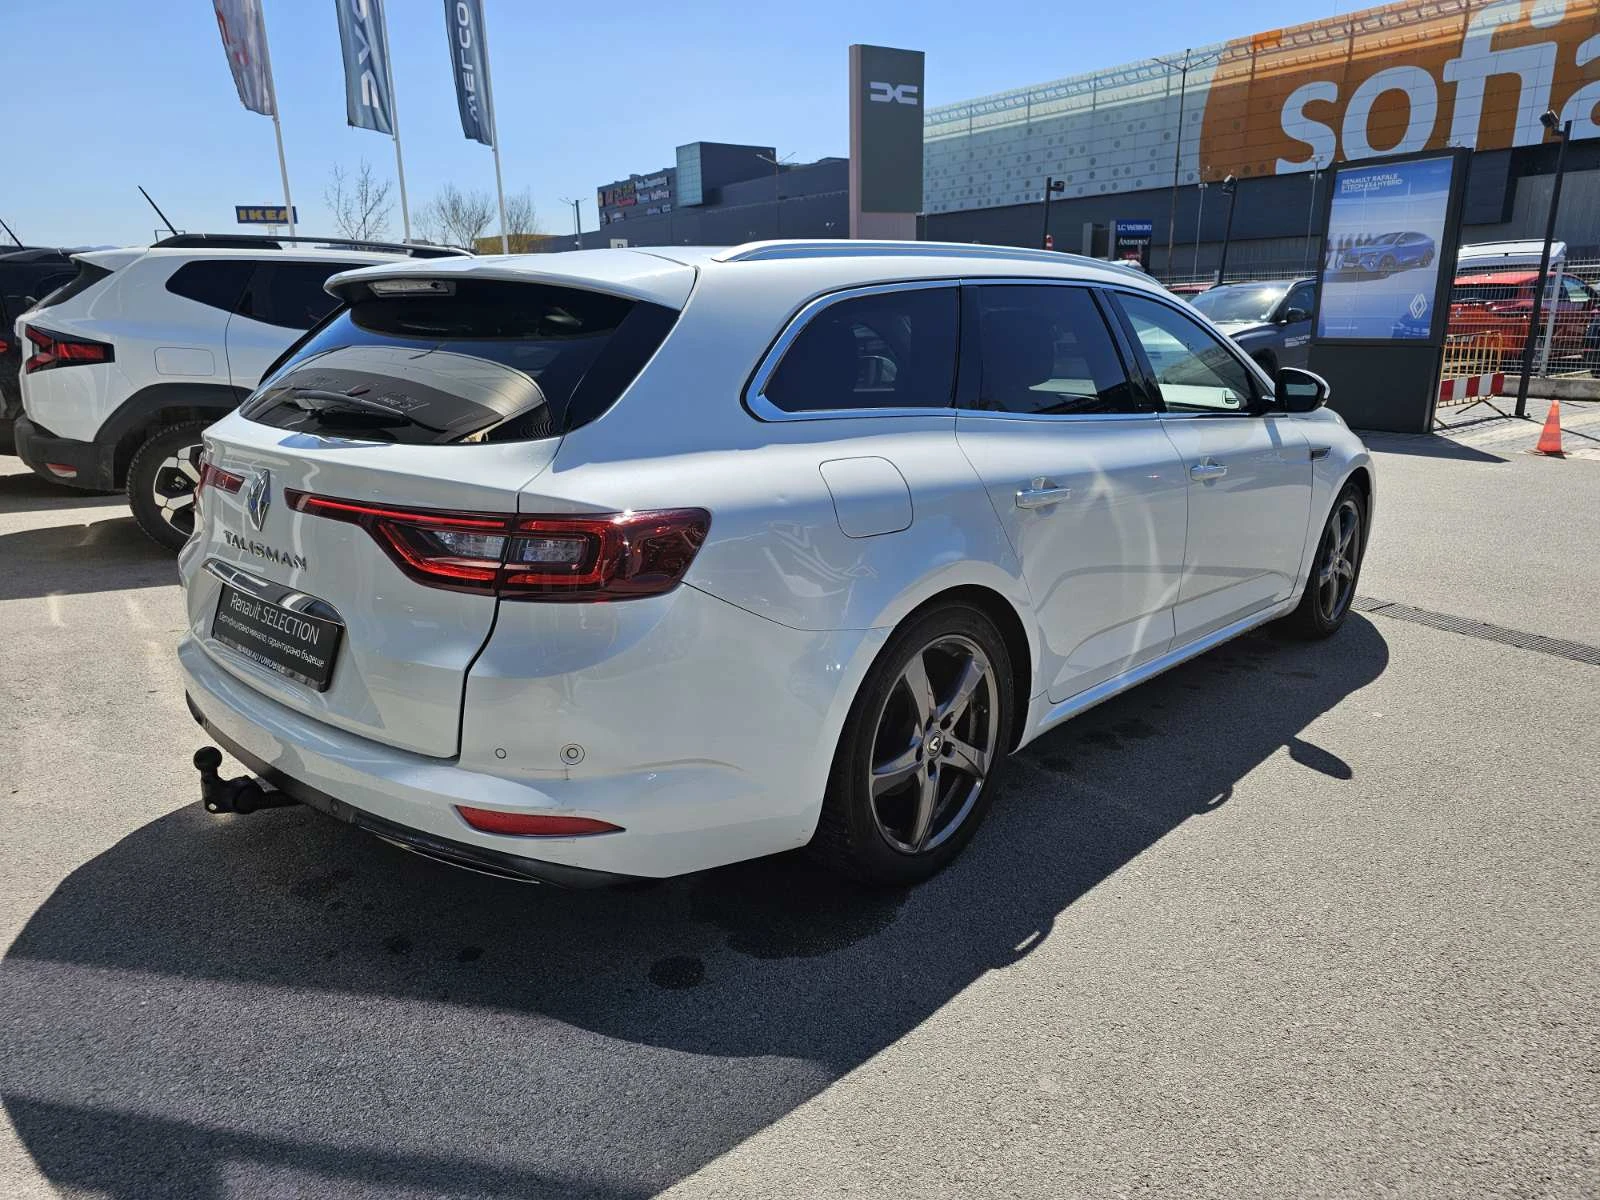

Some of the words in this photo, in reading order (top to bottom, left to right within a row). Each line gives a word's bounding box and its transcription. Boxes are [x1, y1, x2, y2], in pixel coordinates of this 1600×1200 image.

[1343, 176, 1372, 185] RENAULT
[1372, 173, 1398, 181] RAFALE
[1376, 178, 1403, 187] HYBRID
[239, 209, 290, 220] IKEA
[223, 529, 308, 572] TALISMAN
[230, 592, 262, 620] Renault
[261, 606, 320, 645] SELECTION
